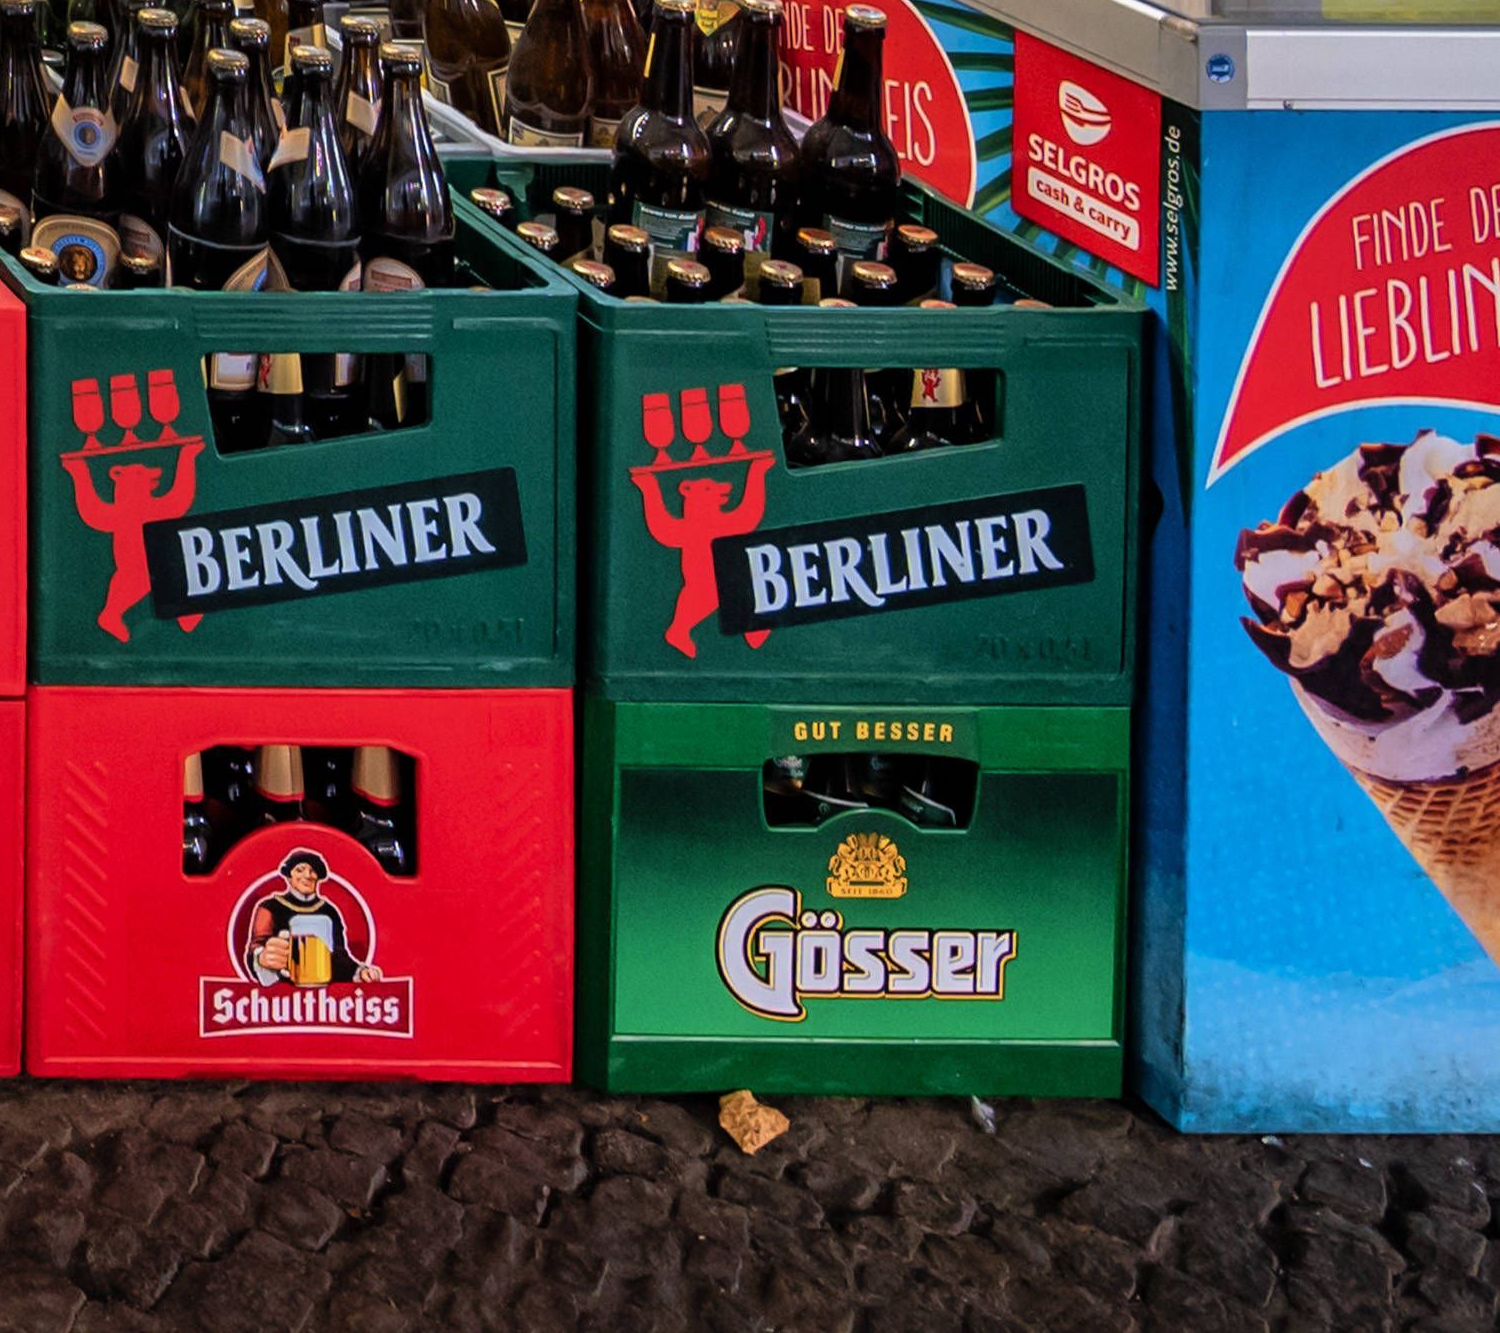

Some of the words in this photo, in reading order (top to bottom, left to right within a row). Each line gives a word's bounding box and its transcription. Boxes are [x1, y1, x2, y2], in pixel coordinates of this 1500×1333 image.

[1027, 133, 1142, 212] SELGROS
[1035, 174, 1070, 207] cash
[1073, 196, 1085, 215] &
[1087, 201, 1132, 242] carry
[1166, 123, 1182, 292] www.selgros.de
[1352, 196, 1452, 271] FINDE
[176, 491, 496, 598] BERLINER
[743, 507, 1066, 616] BERLINER
[793, 720, 840, 743] GUT
[853, 719, 955, 744] BESSER
[718, 885, 1018, 1021] Gösser
[211, 987, 401, 1030] Schultheiss
